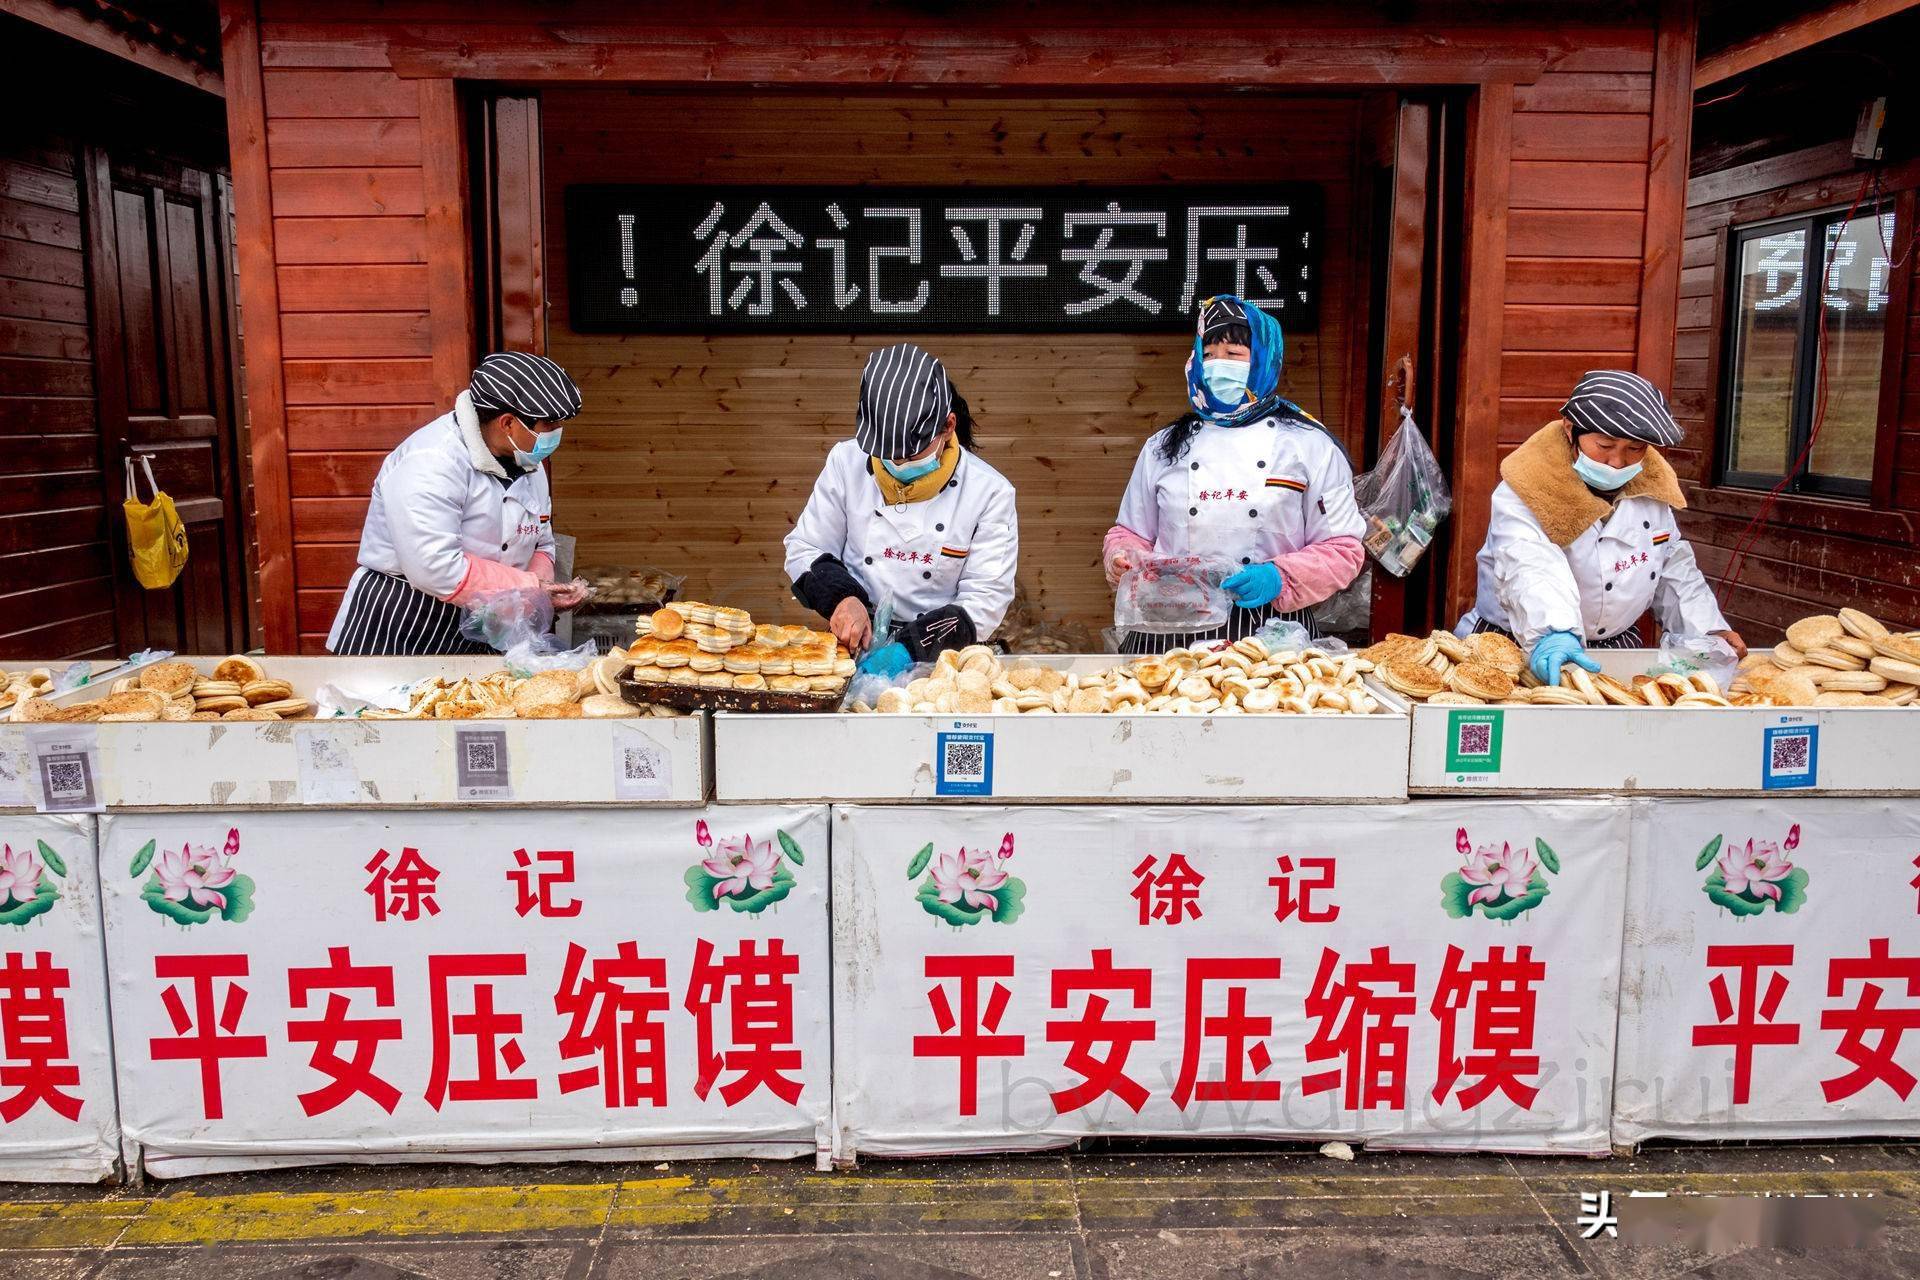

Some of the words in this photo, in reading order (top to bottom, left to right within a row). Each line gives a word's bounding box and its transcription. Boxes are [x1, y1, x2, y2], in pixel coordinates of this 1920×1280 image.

[883, 547, 934, 565] 徐记平安
[1198, 488, 1249, 501] 徐记平安
[149, 937, 805, 1120] 平安压缩馍
[913, 944, 1547, 1116] 平安压缩馍
[1692, 938, 1920, 1105] 平安
